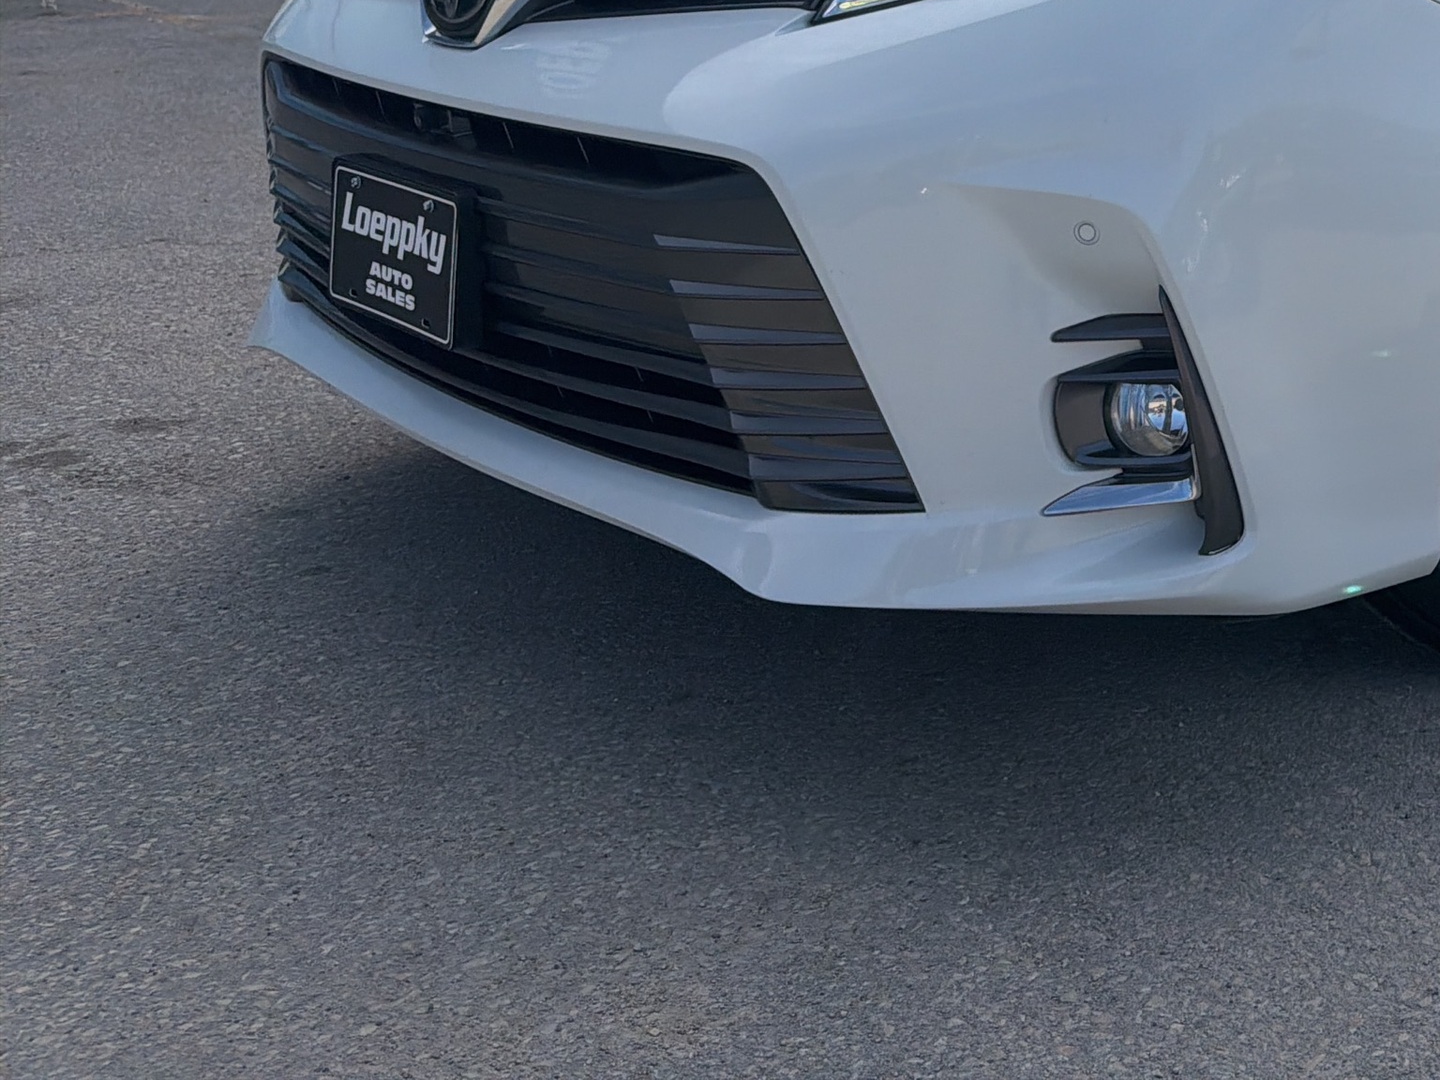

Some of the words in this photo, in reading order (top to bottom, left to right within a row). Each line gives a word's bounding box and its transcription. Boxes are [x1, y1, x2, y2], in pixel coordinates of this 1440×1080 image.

[341, 191, 447, 275] Loeppky
[369, 261, 413, 290] AUTO
[365, 278, 415, 311] SALES
